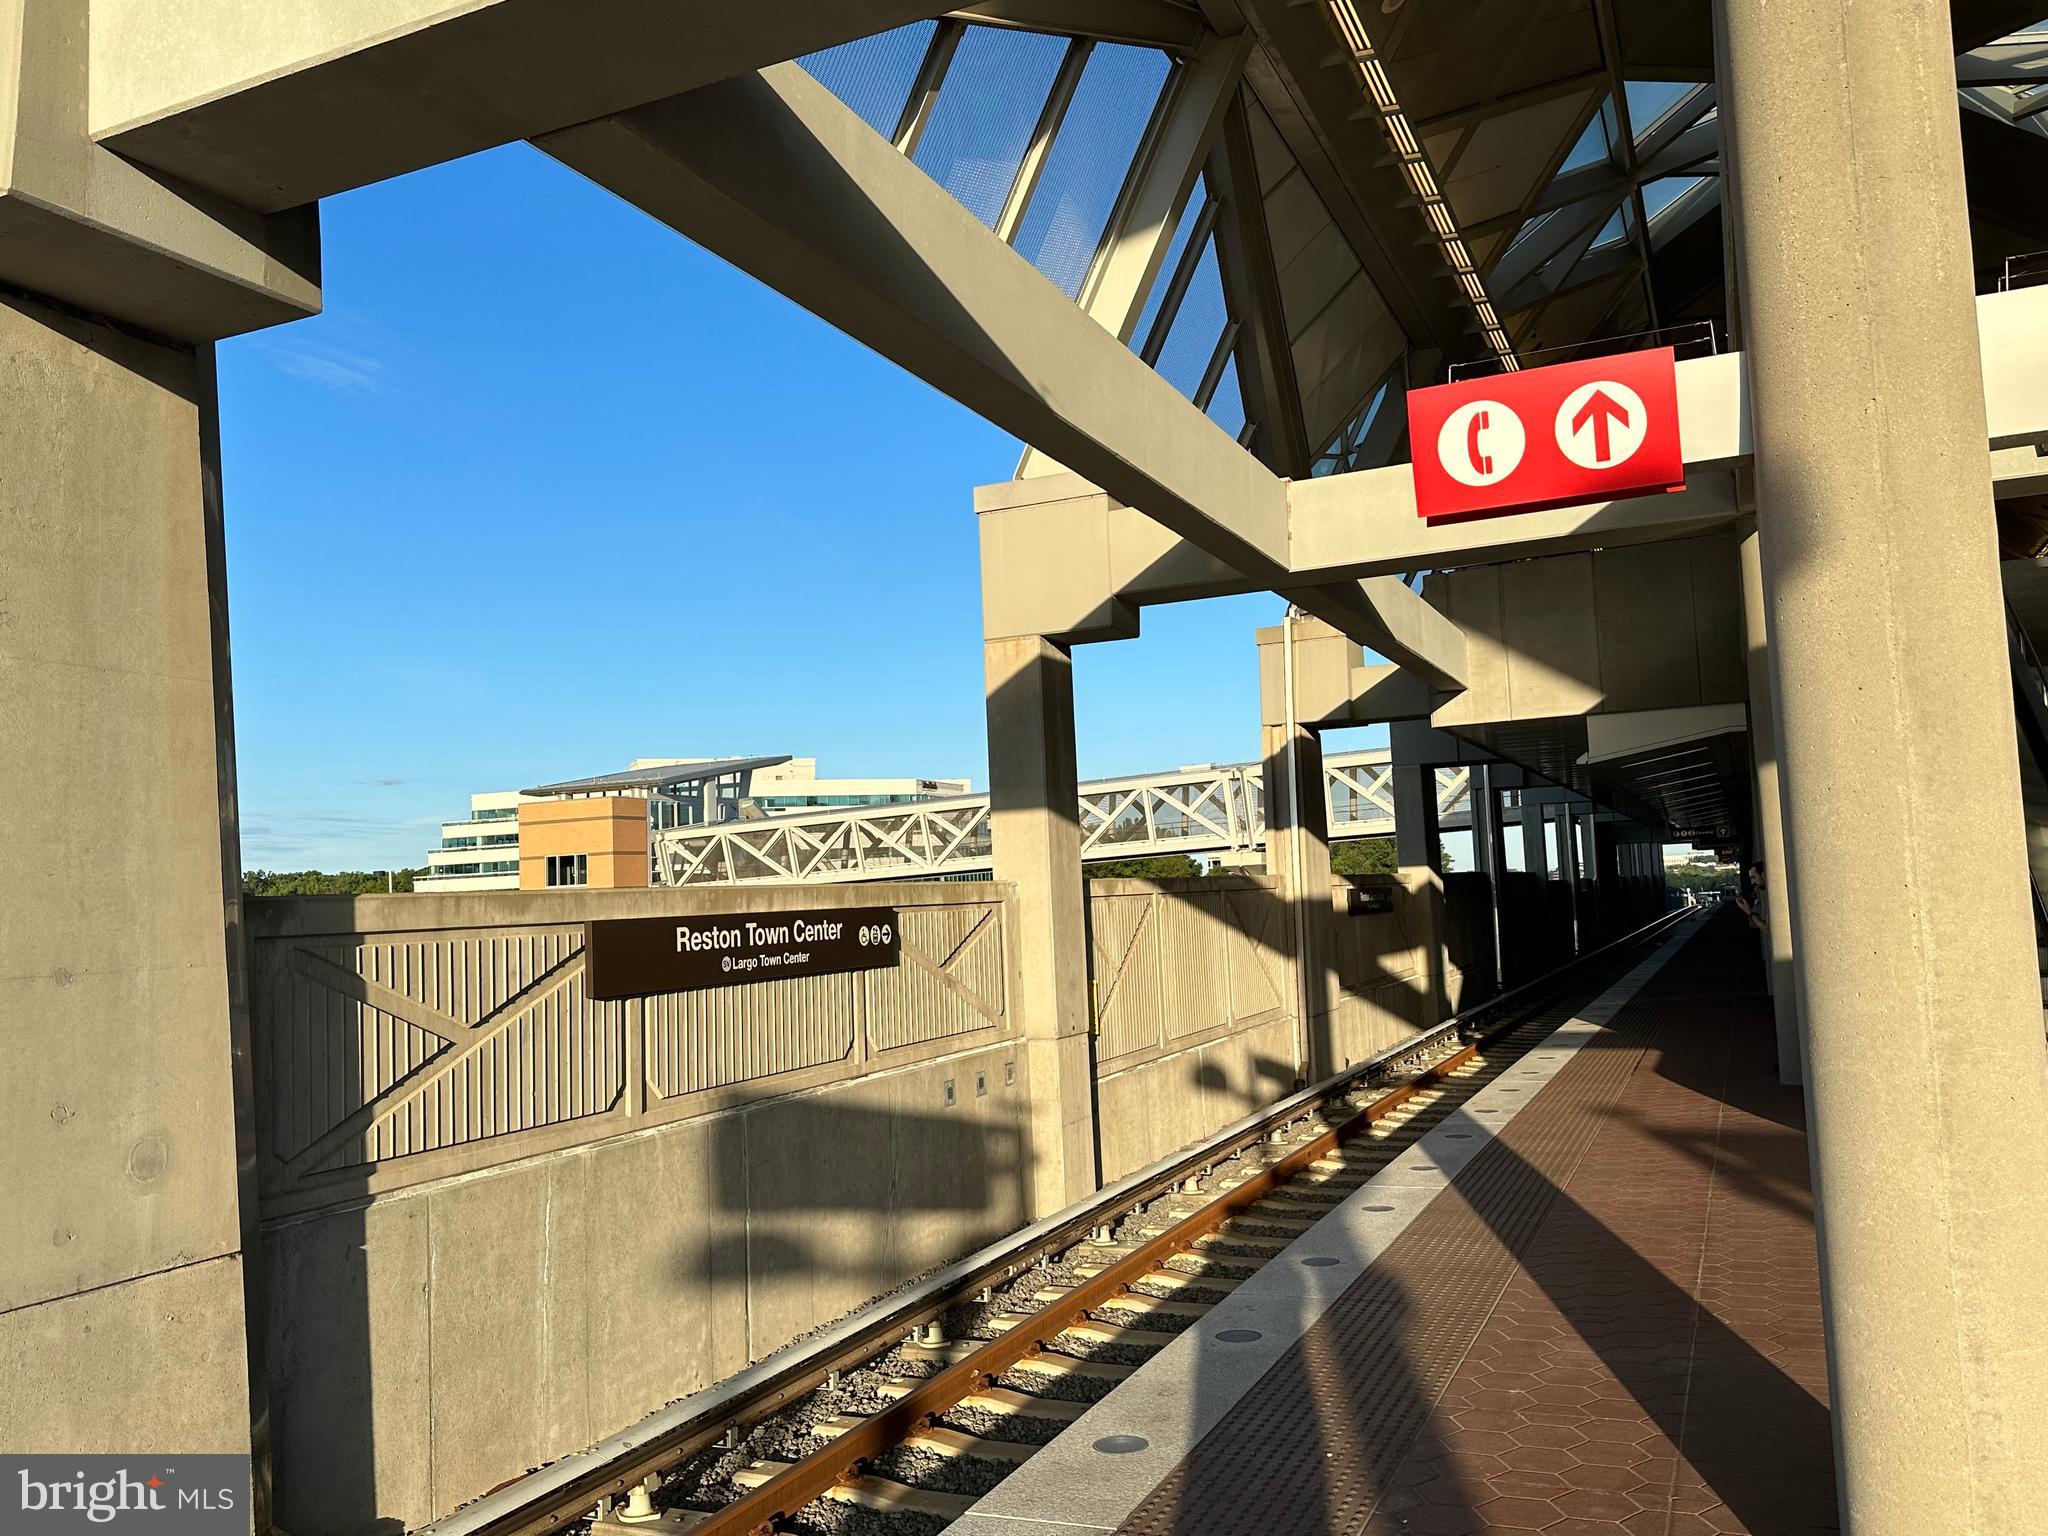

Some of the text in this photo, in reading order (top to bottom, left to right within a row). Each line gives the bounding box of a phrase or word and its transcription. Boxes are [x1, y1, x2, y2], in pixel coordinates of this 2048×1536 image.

[676, 919, 843, 952] Reston Town Center
[732, 957, 758, 972] Largo
[759, 954, 782, 967] Town
[783, 952, 810, 964] Center
